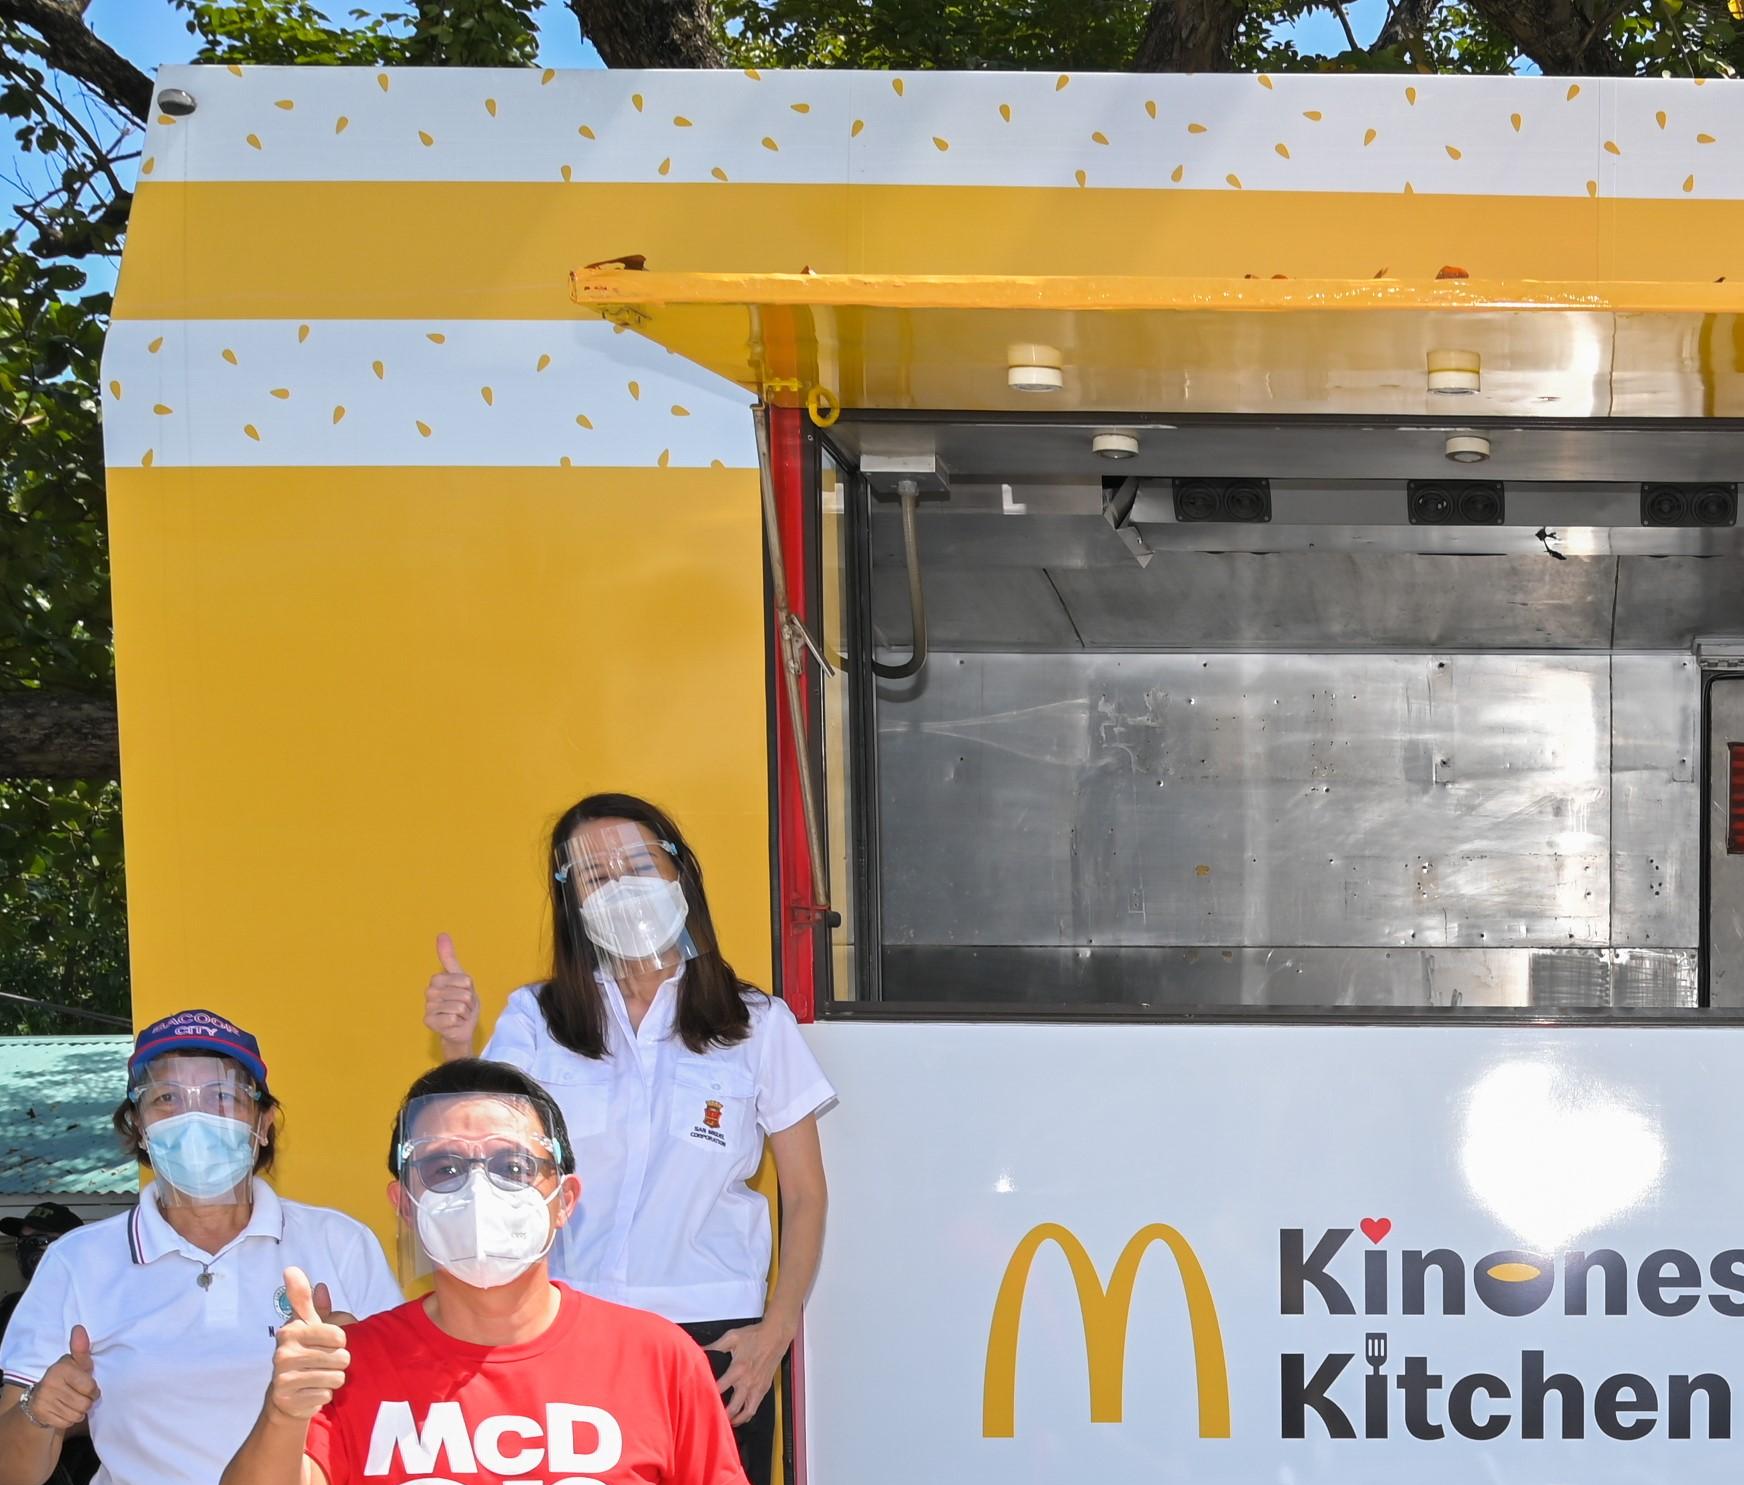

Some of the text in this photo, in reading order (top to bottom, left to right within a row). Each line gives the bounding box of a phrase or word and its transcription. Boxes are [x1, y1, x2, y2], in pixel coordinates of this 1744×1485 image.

[174, 1025, 218, 1037] CITY
[1281, 1333, 1732, 1440] Kitchen
[363, 1400, 623, 1476] McD
